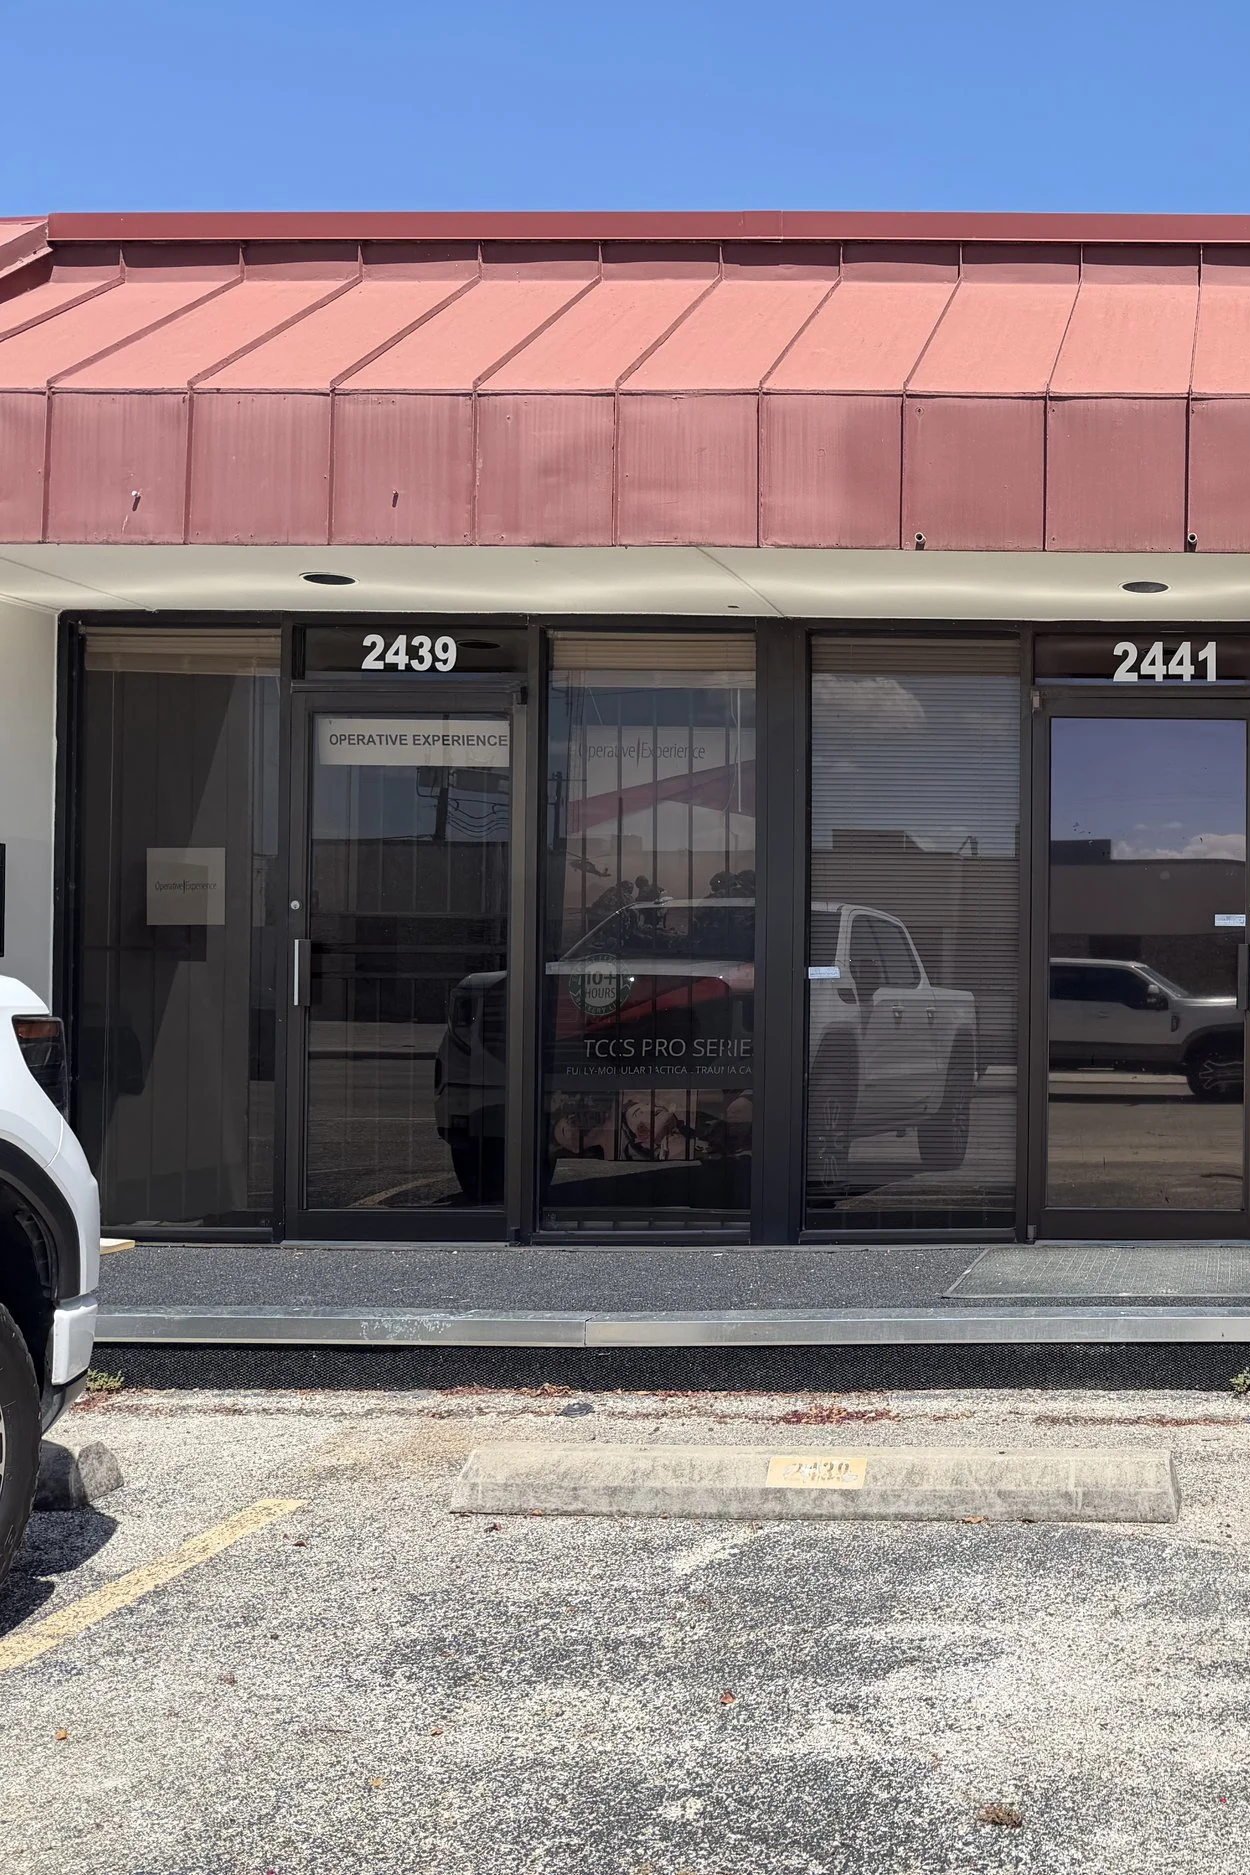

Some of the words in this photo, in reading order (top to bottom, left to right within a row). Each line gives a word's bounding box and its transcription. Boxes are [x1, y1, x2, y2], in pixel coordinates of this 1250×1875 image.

[361, 634, 457, 672] 2439
[1112, 641, 1217, 682] 2441
[329, 734, 409, 746] OPERATIVE
[412, 734, 508, 747] EXPERIENCE
[578, 742, 635, 761] peratve
[585, 987, 616, 999] HOURS
[642, 1039, 686, 1057] PRO
[692, 1039, 754, 1057] SERIE
